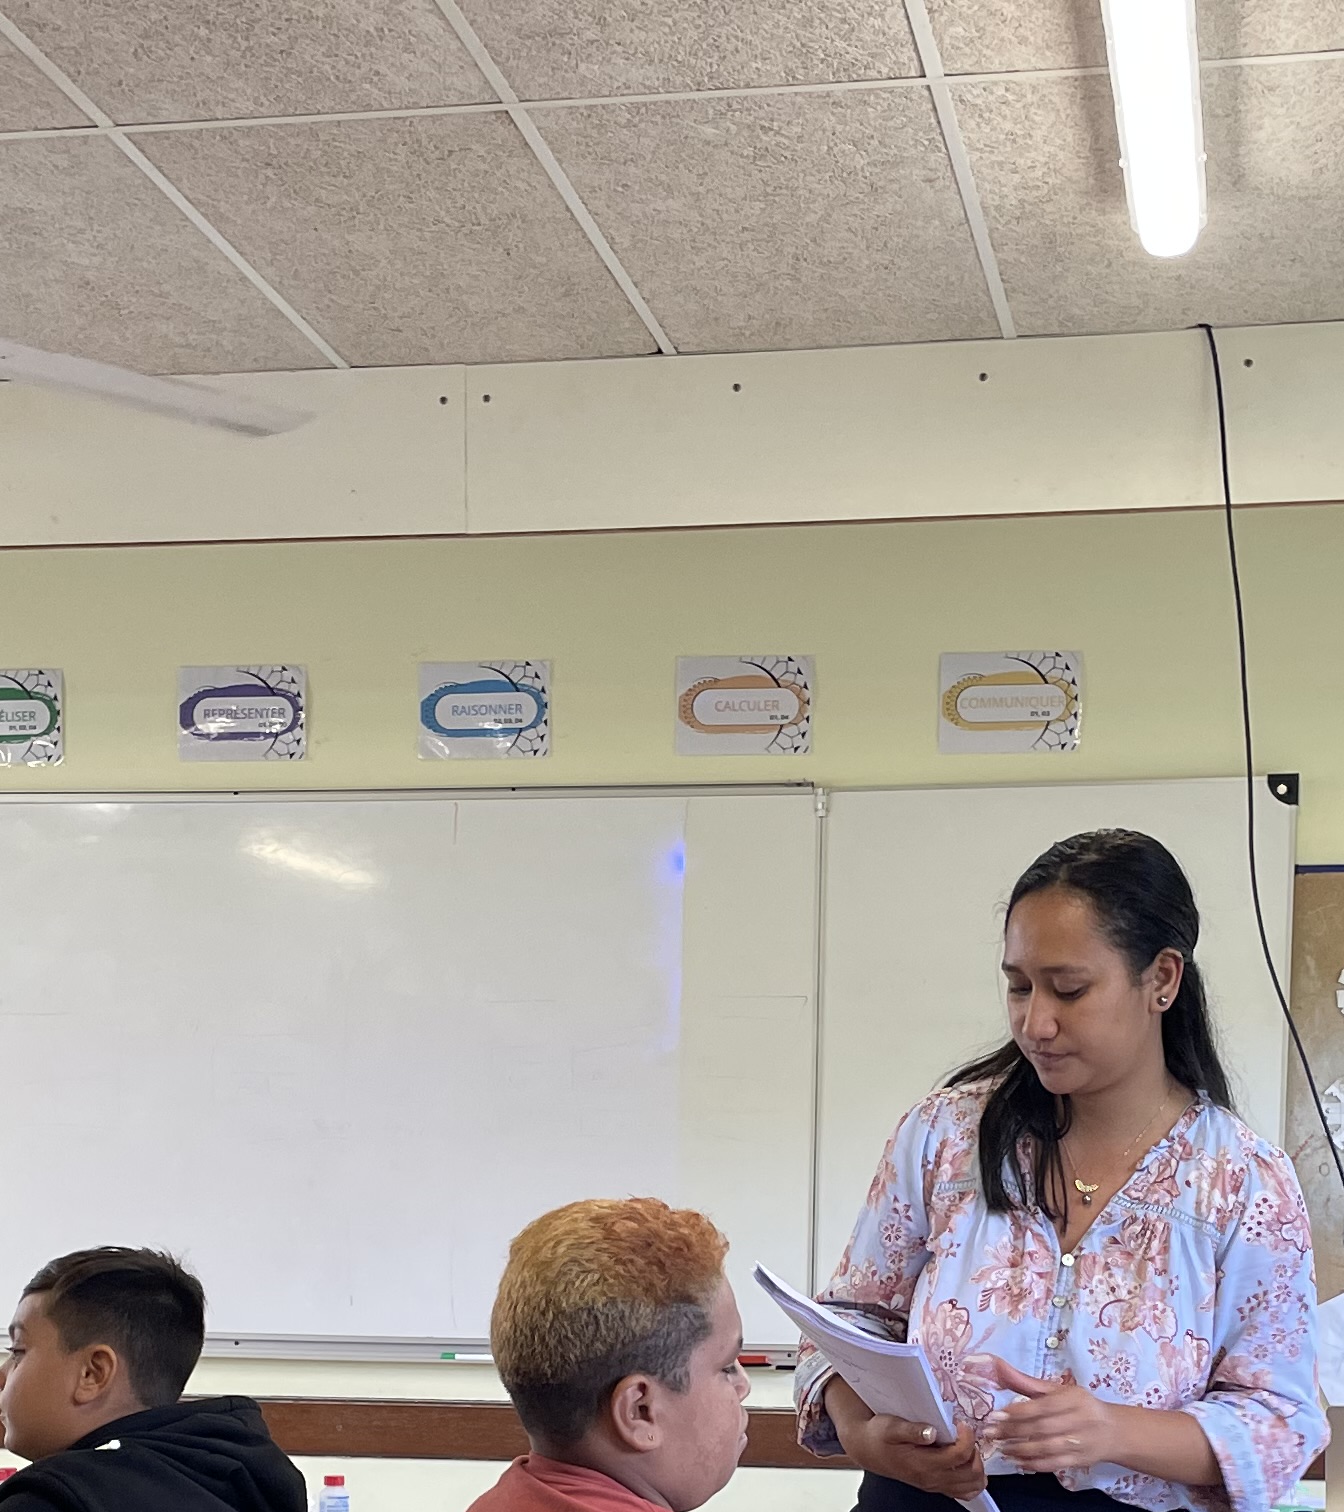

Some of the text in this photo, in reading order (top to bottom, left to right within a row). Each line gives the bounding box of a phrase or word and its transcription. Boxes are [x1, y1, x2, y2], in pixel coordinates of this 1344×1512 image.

[714, 700, 780, 712] CALCULER
[959, 695, 1066, 709] COMMUNIQUER
[203, 705, 286, 720] REPRÉSENTER
[451, 704, 523, 716] RAISONNER
